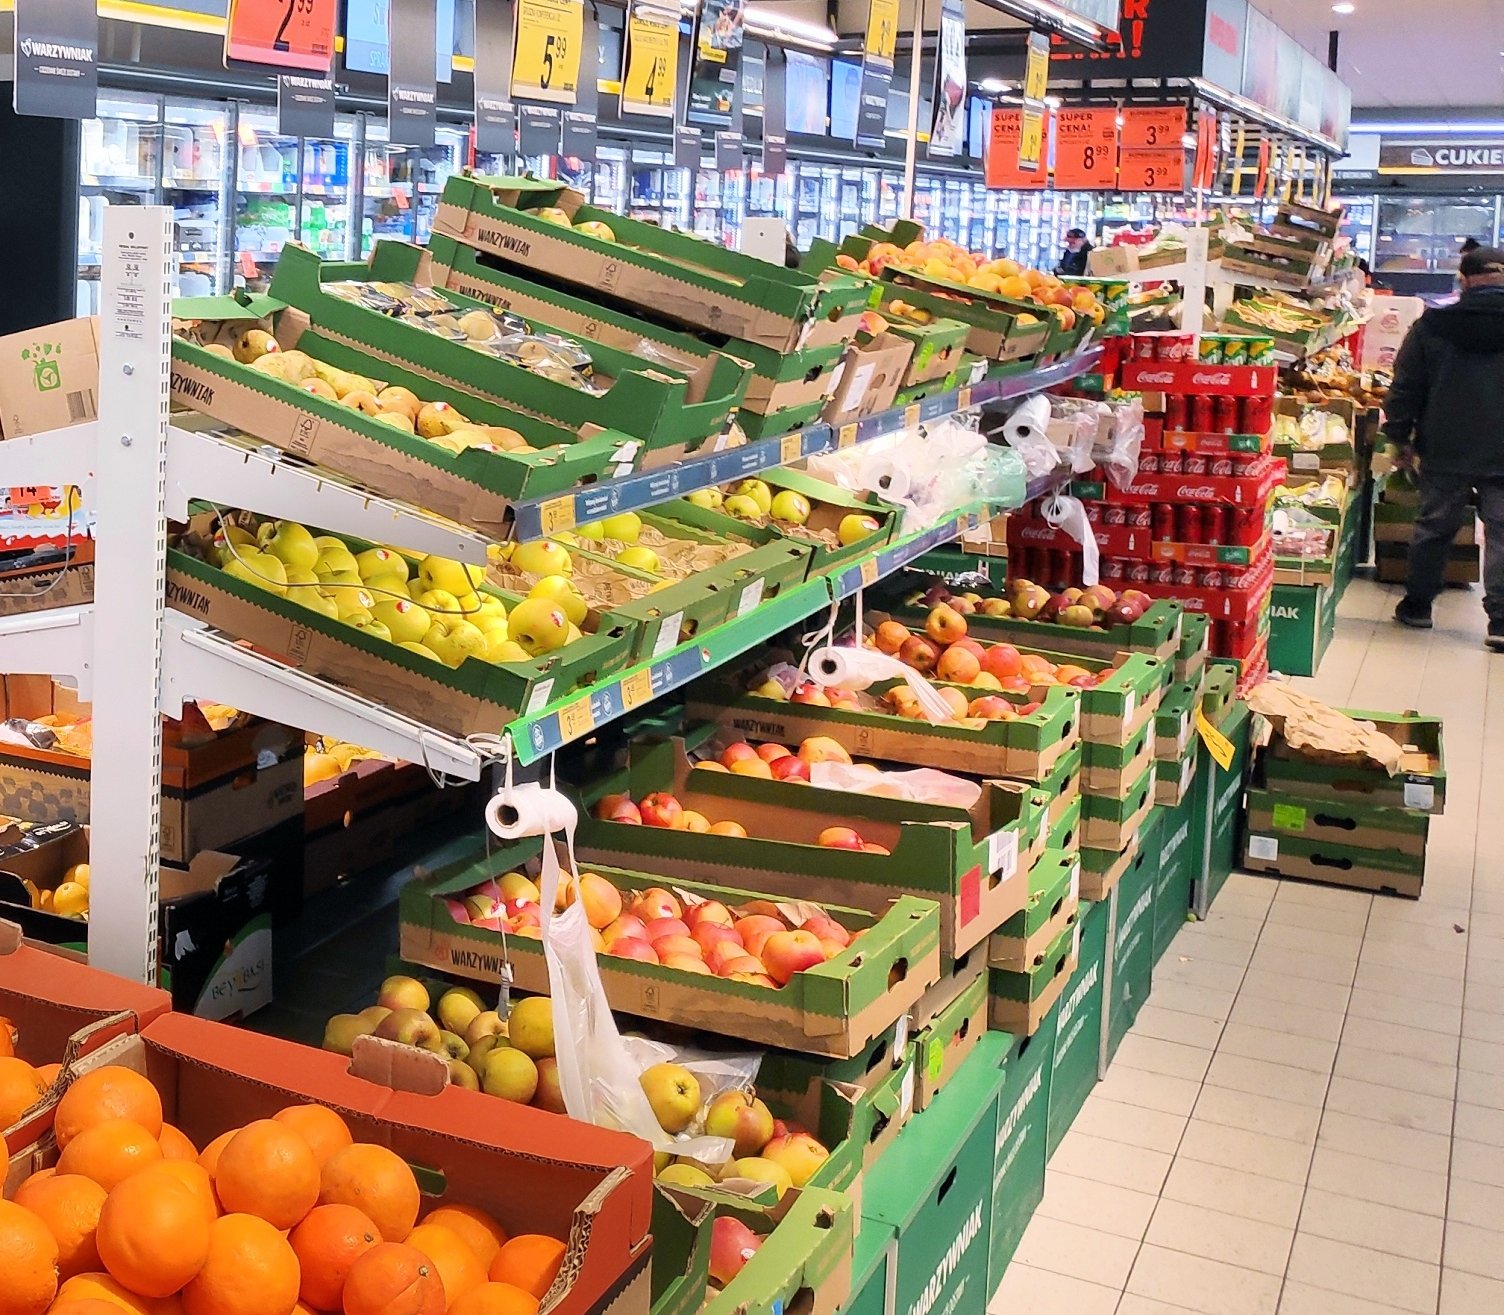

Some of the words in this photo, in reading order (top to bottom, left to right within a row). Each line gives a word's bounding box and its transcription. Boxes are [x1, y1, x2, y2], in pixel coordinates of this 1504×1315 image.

[31, 41, 94, 62] WARZYWNIAK
[540, 35, 555, 89] 5
[556, 36, 567, 59] 99
[995, 113, 1020, 122] SUPE
[1060, 113, 1093, 122] SUPER
[994, 124, 1021, 132] CENA
[1059, 124, 1091, 132] CENA!
[1146, 125, 1156, 145] 3
[1158, 125, 1170, 133] 99
[1083, 146, 1094, 170] 8
[1096, 146, 1109, 156] 99
[1144, 167, 1155, 187] 3
[478, 227, 531, 257] WARZYWNIAK
[1136, 371, 1175, 384] Coca-Cola
[1193, 372, 1232, 386] Coca-Cola
[1177, 484, 1216, 498] Coca-Cola
[1271, 605, 1299, 619] IAK
[451, 949, 515, 982] WARZYWNI
